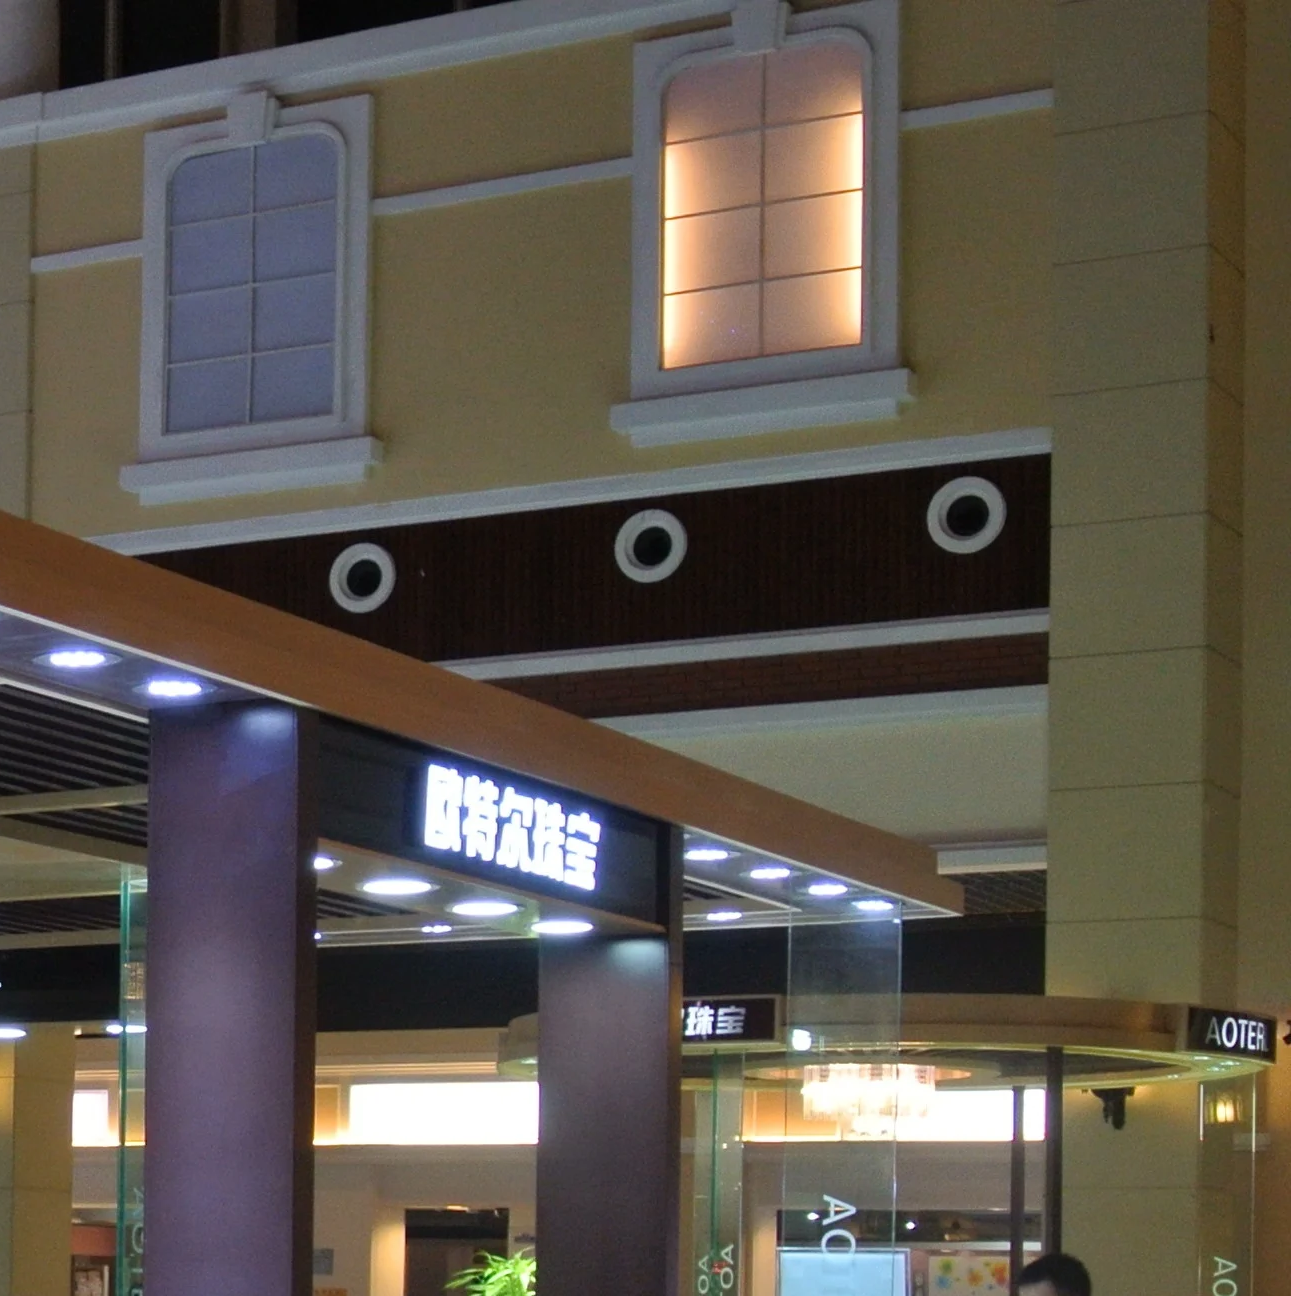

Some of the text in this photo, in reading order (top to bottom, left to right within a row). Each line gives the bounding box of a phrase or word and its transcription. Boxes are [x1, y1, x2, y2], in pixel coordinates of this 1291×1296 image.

[424, 764, 601, 891] 欧特尔珠宝
[681, 1001, 746, 1040] 珠宝
